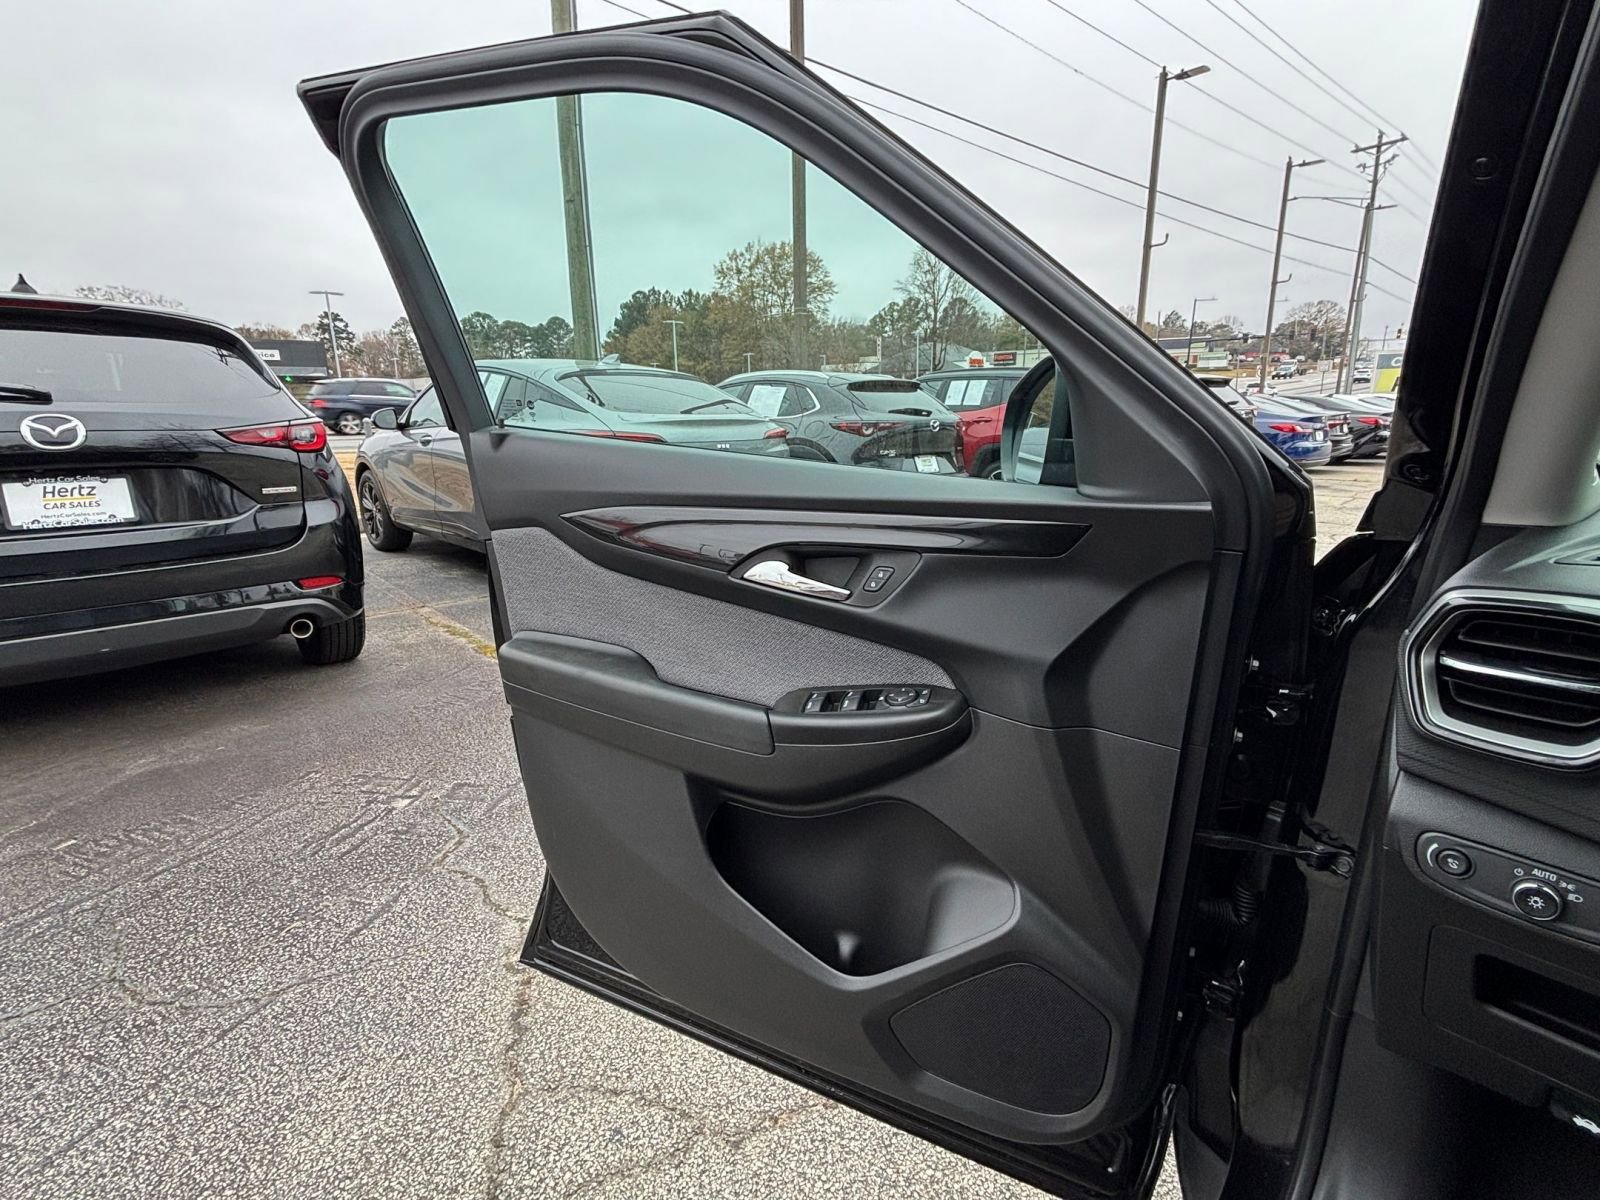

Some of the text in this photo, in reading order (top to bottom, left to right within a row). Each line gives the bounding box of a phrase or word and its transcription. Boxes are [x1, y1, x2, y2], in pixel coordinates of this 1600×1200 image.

[28, 477, 55, 485] Hertz
[43, 485, 96, 498] Hertz
[43, 500, 101, 510] CAR SALES
[1532, 868, 1556, 881] AUTO
